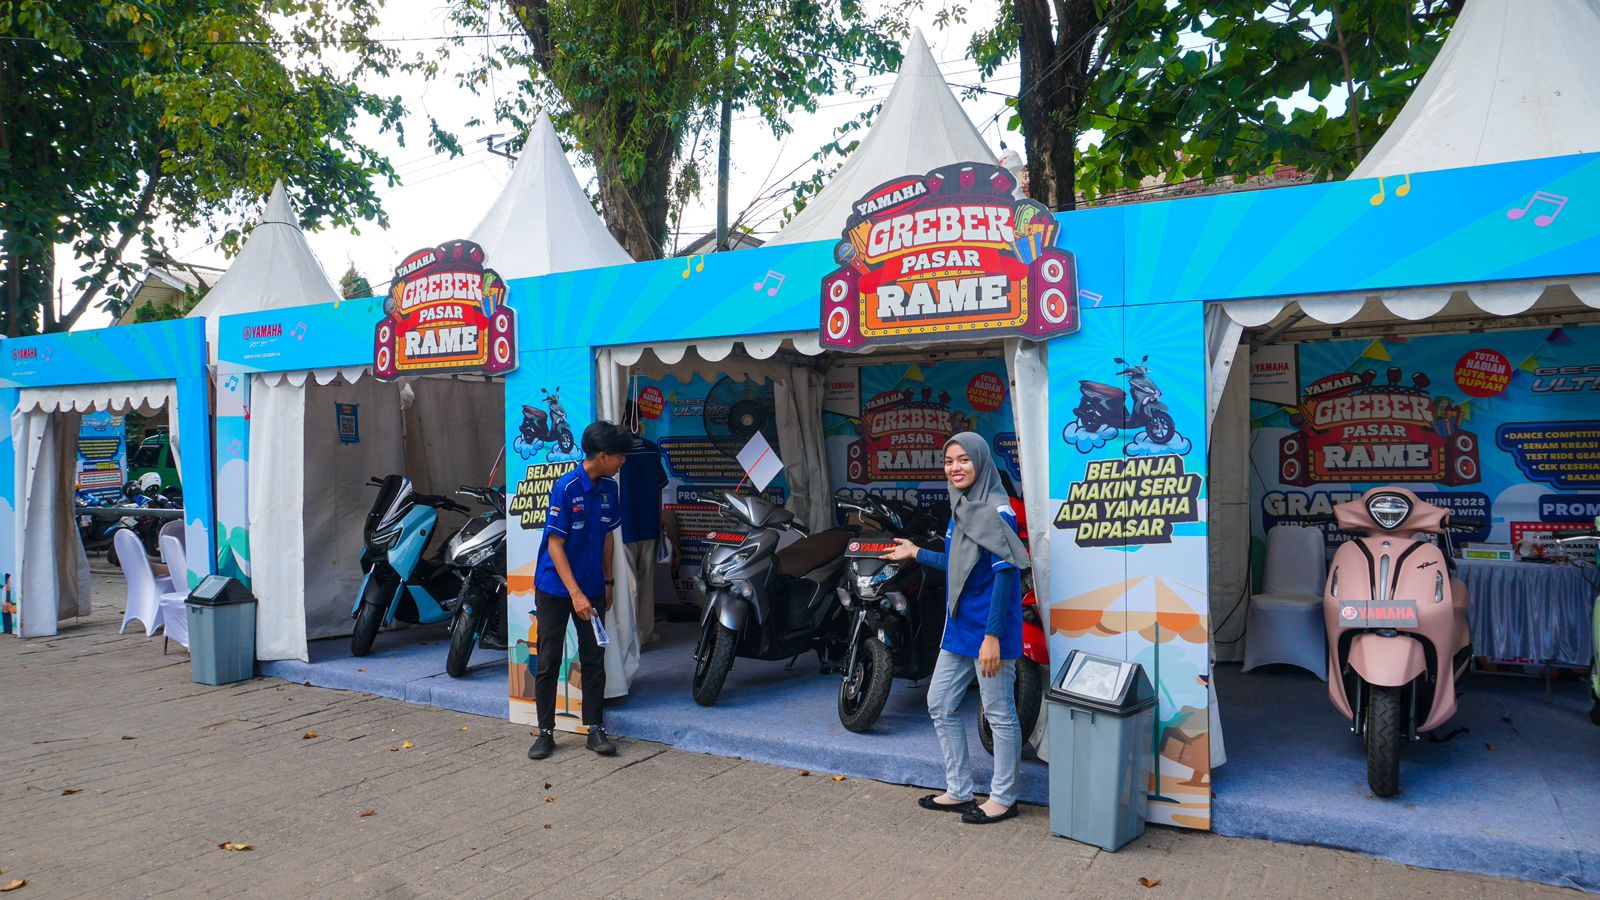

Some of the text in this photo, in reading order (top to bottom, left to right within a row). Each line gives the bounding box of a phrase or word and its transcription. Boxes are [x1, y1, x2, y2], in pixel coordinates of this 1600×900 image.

[857, 181, 927, 216] YAMAHA
[867, 206, 1015, 257] GREBEK
[397, 252, 436, 278] YAMAHA
[901, 250, 981, 274] PASAR
[876, 275, 1008, 318] RAME
[419, 305, 463, 323] PASAR
[252, 323, 282, 339] YAMAHA
[405, 326, 478, 356] RAME
[1474, 352, 1500, 363] TOTAL
[1255, 362, 1289, 372] YAMAHA
[1466, 358, 1506, 375] HADIAH
[1456, 368, 1508, 384] JUTA-AN
[831, 380, 855, 389] YAMAHA
[1304, 374, 1362, 396] YAMAHA
[1458, 377, 1504, 392] RUPIAH
[865, 392, 904, 408] YAMAHA
[890, 433, 934, 445] PASAR
[1343, 425, 1407, 438] PASAR
[1523, 441, 1599, 450] SENAM KREASI
[1323, 444, 1431, 468] RAME
[1087, 457, 1177, 481] BELANJA
[1537, 463, 1600, 471] CEK KESEHA
[517, 480, 553, 495] MAKIN
[1069, 476, 1193, 501] MAKIN SERU
[511, 496, 533, 511] ADA
[1057, 497, 1191, 522] ADA YAMAHA
[1263, 492, 1363, 516] GRAT
[1454, 497, 1486, 506] 2025
[1543, 503, 1600, 516] PROM
[522, 509, 546, 524] DIPA
[1458, 508, 1486, 516] WITA
[1077, 518, 1165, 540] DIPASAR
[1358, 606, 1415, 620] YAMAHA
